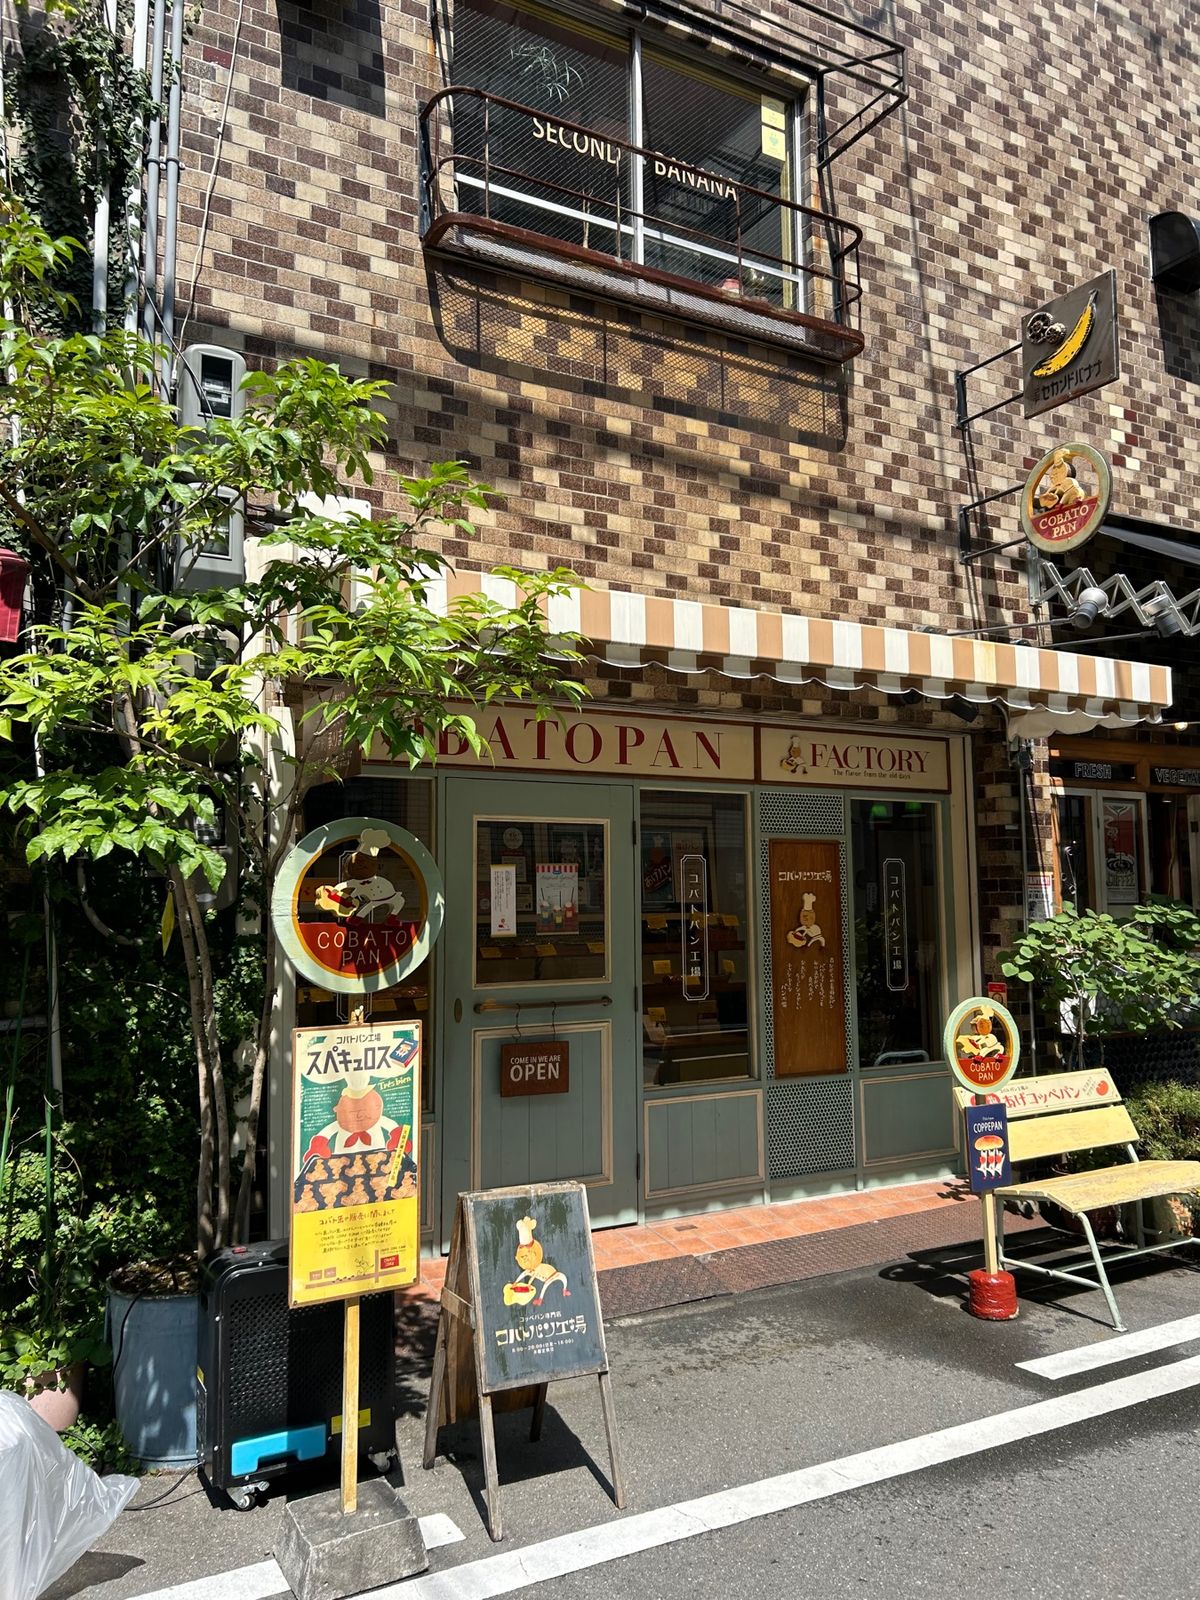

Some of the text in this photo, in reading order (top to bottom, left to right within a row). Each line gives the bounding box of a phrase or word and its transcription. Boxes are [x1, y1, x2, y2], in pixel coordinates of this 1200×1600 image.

[1042, 360, 1103, 400] セカンドバナナ
[1038, 504, 1090, 531] COBATO
[1051, 521, 1078, 539] PAN
[381, 715, 724, 771] BATOPAN
[810, 743, 930, 773] FACTORY
[1074, 762, 1112, 779] FRESH
[688, 872, 701, 978] コバトパン工場
[889, 875, 902, 970] コバトパン工場
[317, 929, 408, 950] COBATO
[342, 948, 381, 967] PAN
[336, 1032, 381, 1045] コバトパン工場
[306, 1045, 392, 1076] スペキュロス
[510, 1056, 528, 1065] COME
[538, 1055, 548, 1063] WE
[549, 1054, 561, 1062] ARE
[970, 1061, 1001, 1073] COBATO
[395, 1076, 412, 1086] bien
[510, 1062, 560, 1082] OPEN
[978, 1071, 994, 1081] PAN
[973, 1120, 1003, 1134] COPPEPAN
[495, 1315, 587, 1346] コバトパン工場
